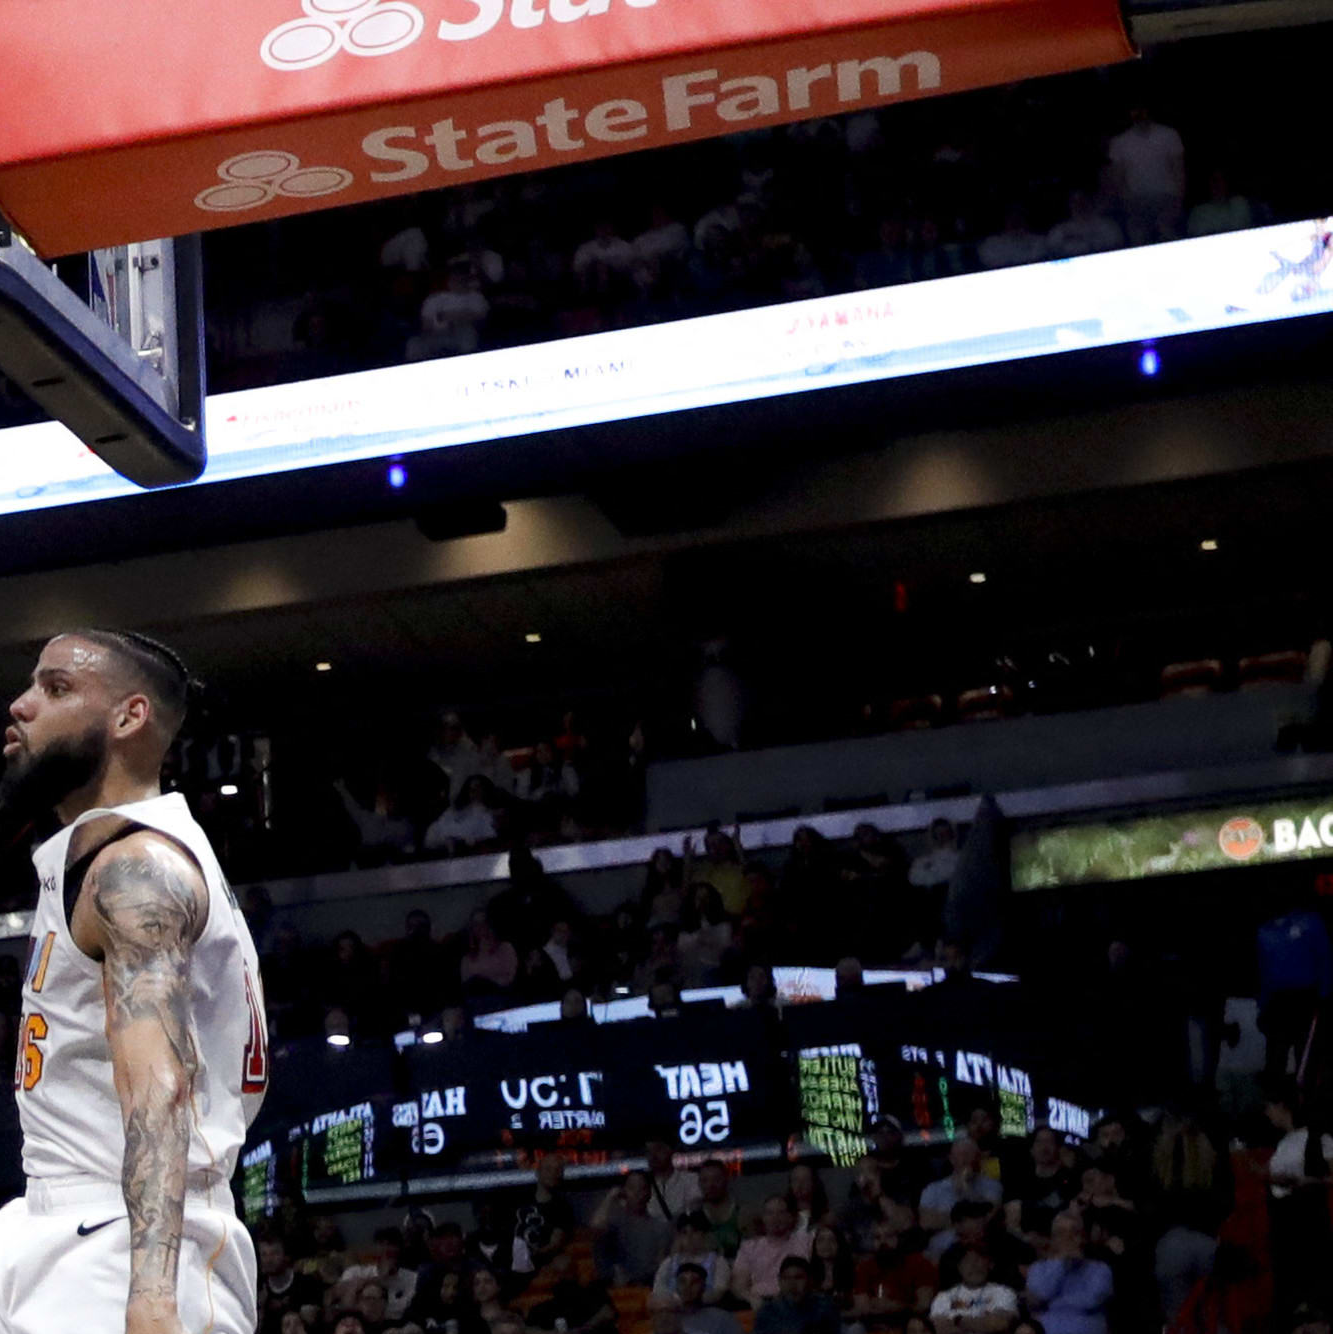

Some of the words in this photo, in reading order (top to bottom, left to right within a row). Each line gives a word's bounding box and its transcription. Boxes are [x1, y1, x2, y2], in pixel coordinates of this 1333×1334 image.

[361, 97, 647, 184] State
[663, 49, 941, 131] Farm
[15, 1013, 48, 1091] 6
